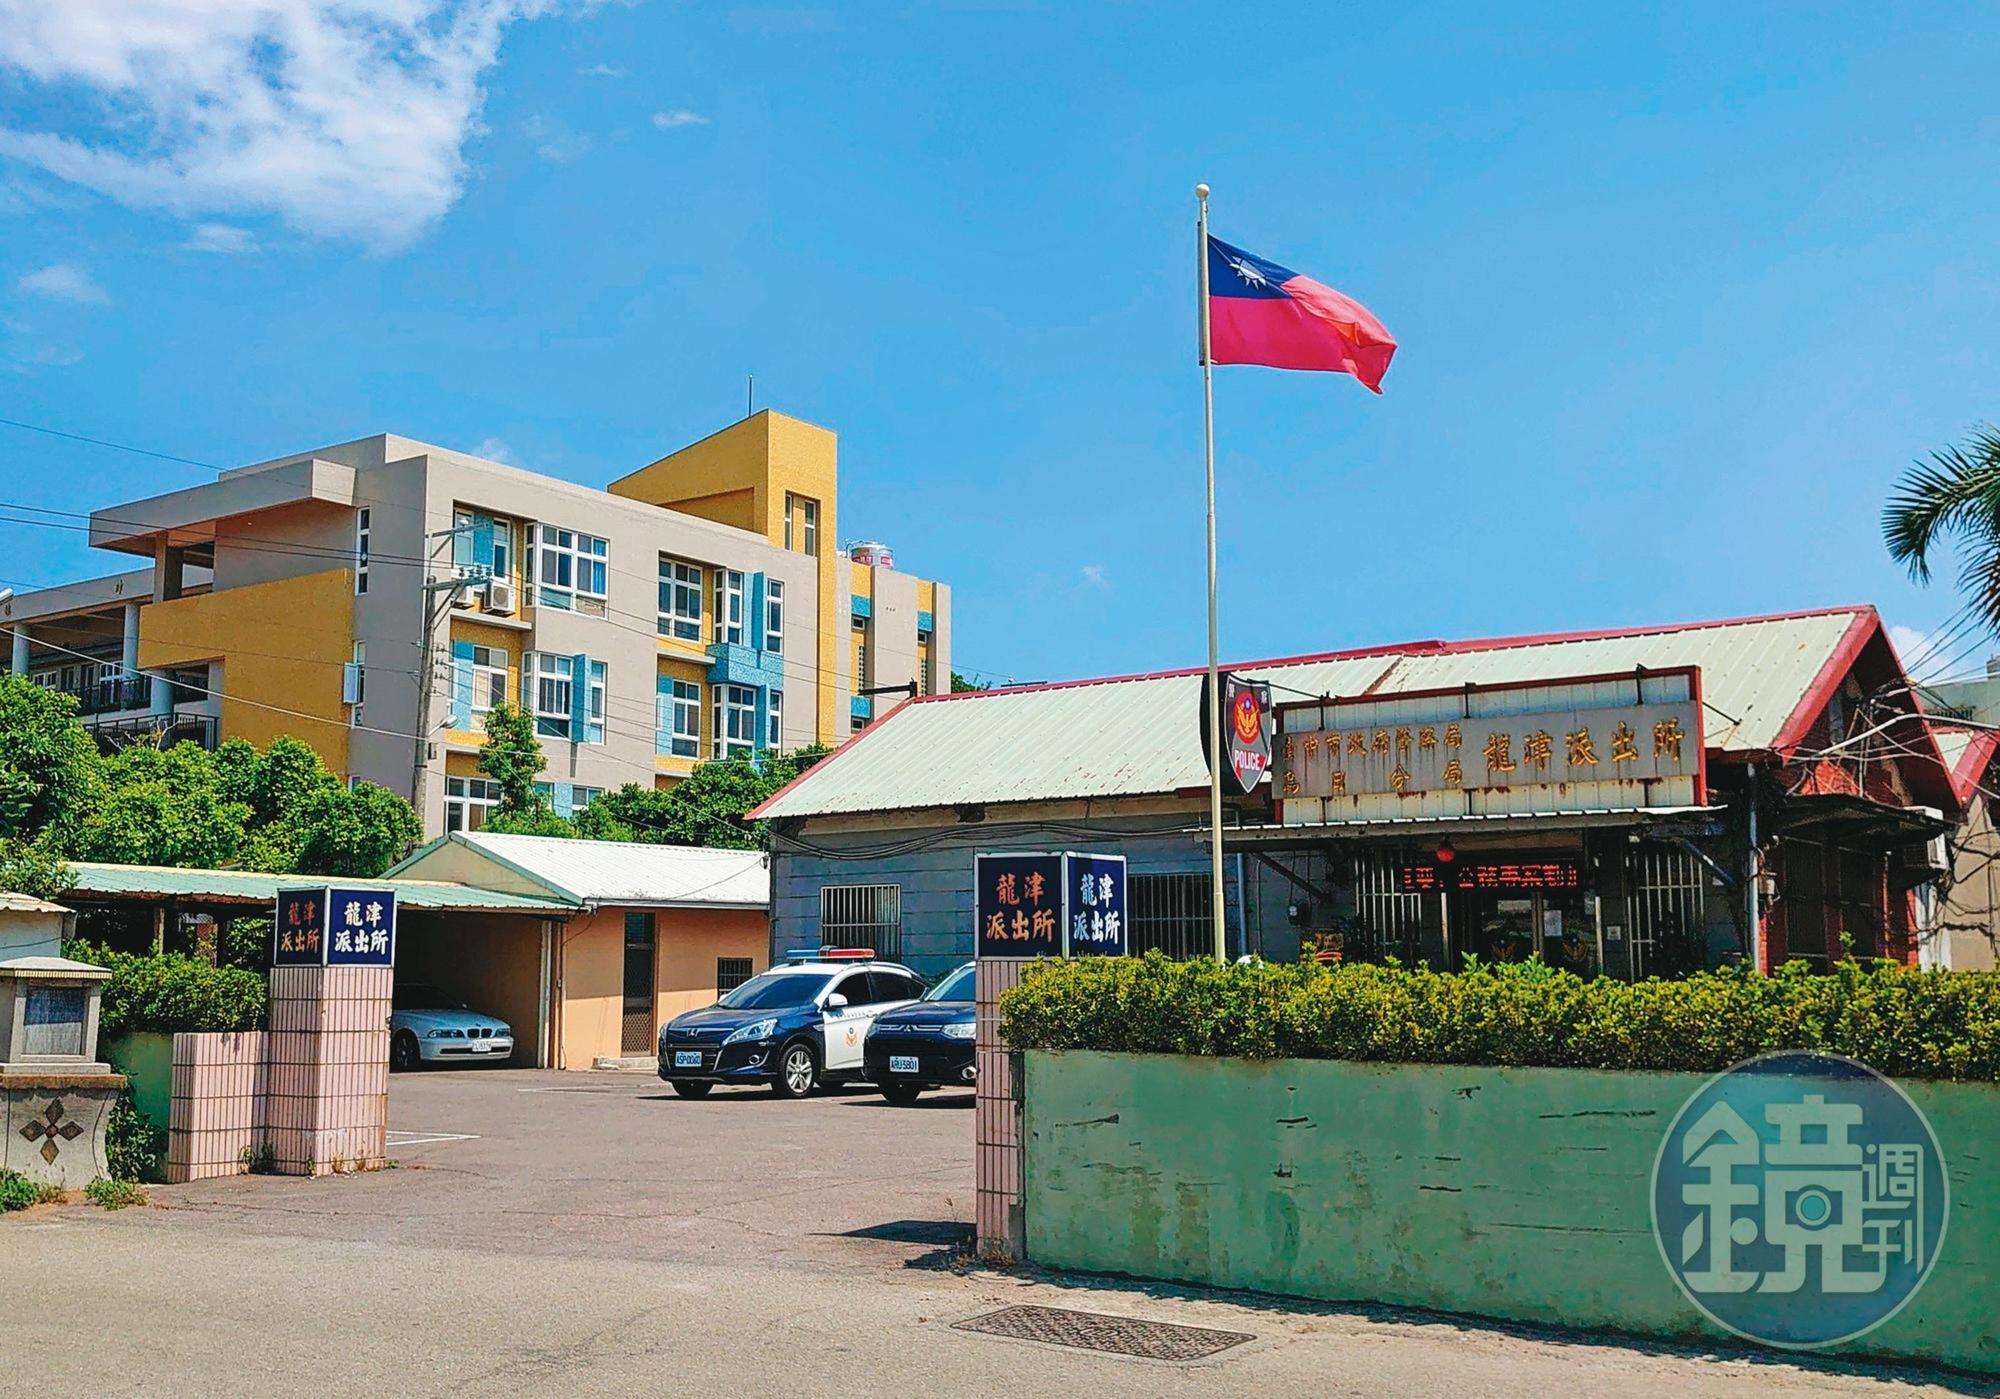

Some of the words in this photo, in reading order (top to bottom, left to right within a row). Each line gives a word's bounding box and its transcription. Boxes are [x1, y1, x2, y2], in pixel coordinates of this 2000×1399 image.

[1234, 749, 1261, 771] POLICE
[1483, 716, 1686, 773] 龍津派出所
[996, 871, 1046, 907] 龍津
[1080, 873, 1114, 908] 龍津
[288, 900, 317, 926] 龍津
[343, 901, 383, 928] 龍津
[986, 908, 1056, 943] 派出所
[1073, 910, 1121, 945] 派出所
[281, 928, 320, 954] 派出所
[334, 928, 389, 956] 派出所
